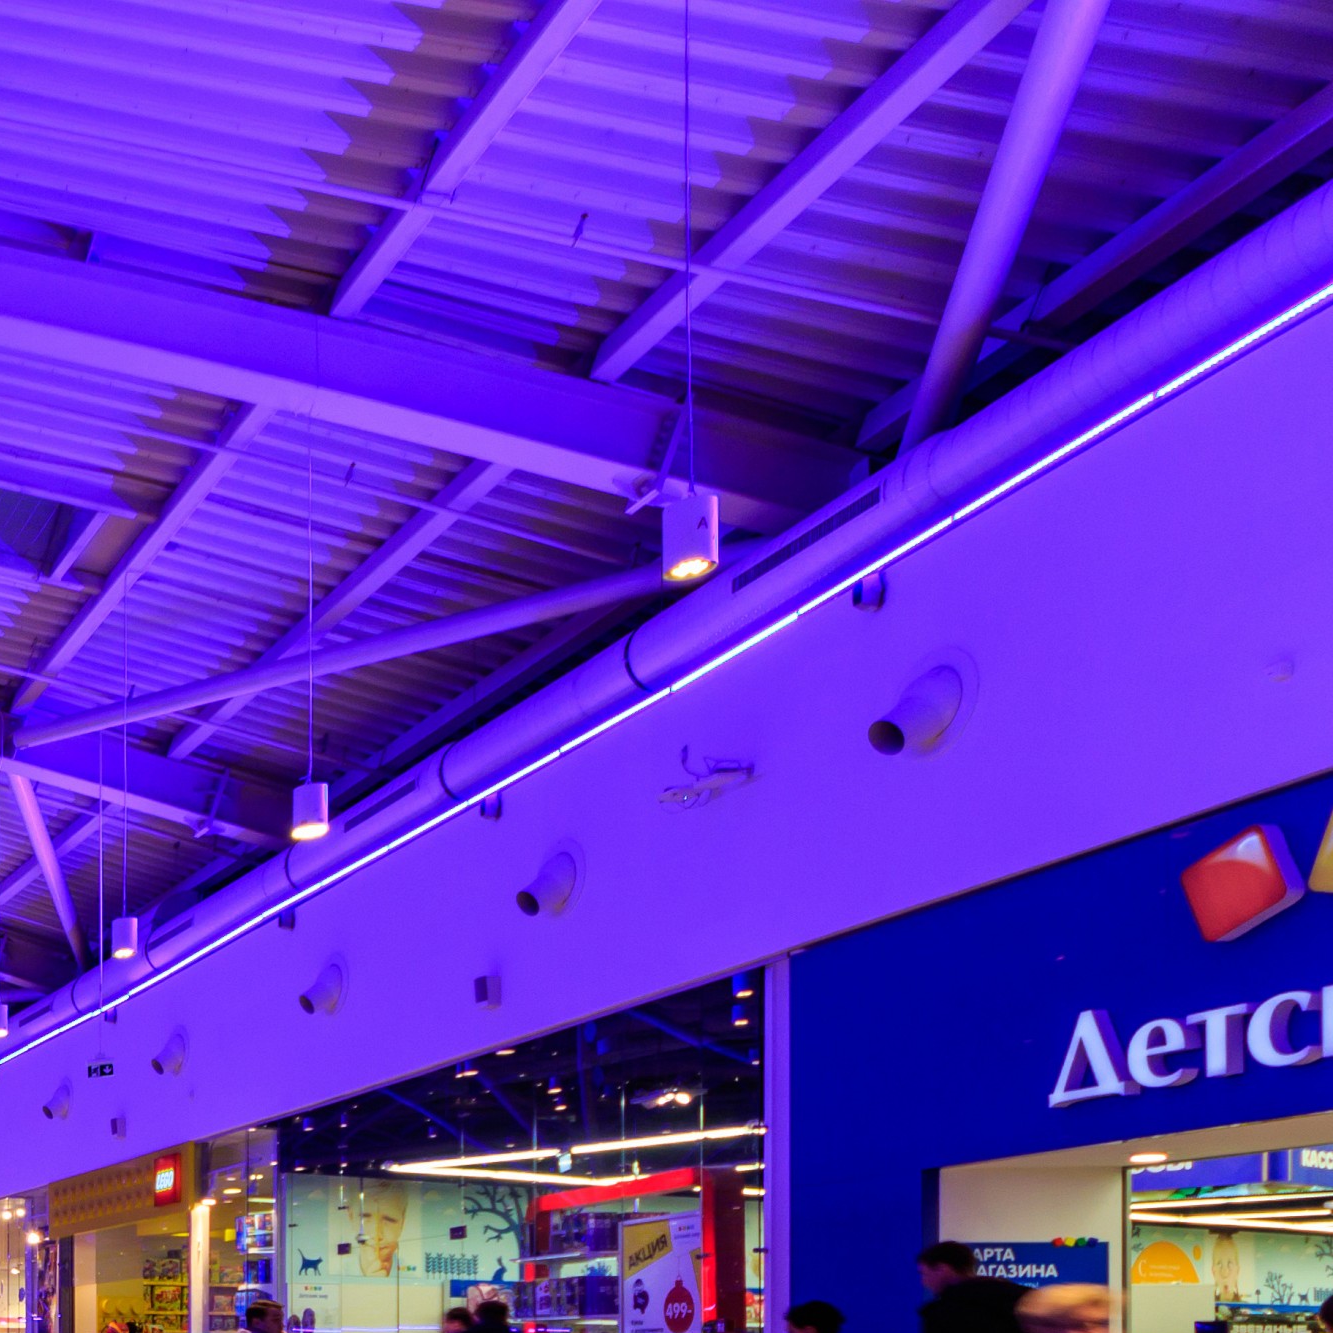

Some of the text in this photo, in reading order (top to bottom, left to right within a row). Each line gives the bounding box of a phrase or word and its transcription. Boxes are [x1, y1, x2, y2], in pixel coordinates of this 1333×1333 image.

[1048, 985, 1333, 1109] Детс
[155, 1167, 175, 1193] LEGO
[628, 1234, 669, 1270] АКЦИЯ
[971, 1247, 1015, 1262] АРТА
[976, 1263, 1058, 1279] АГАЗИНА
